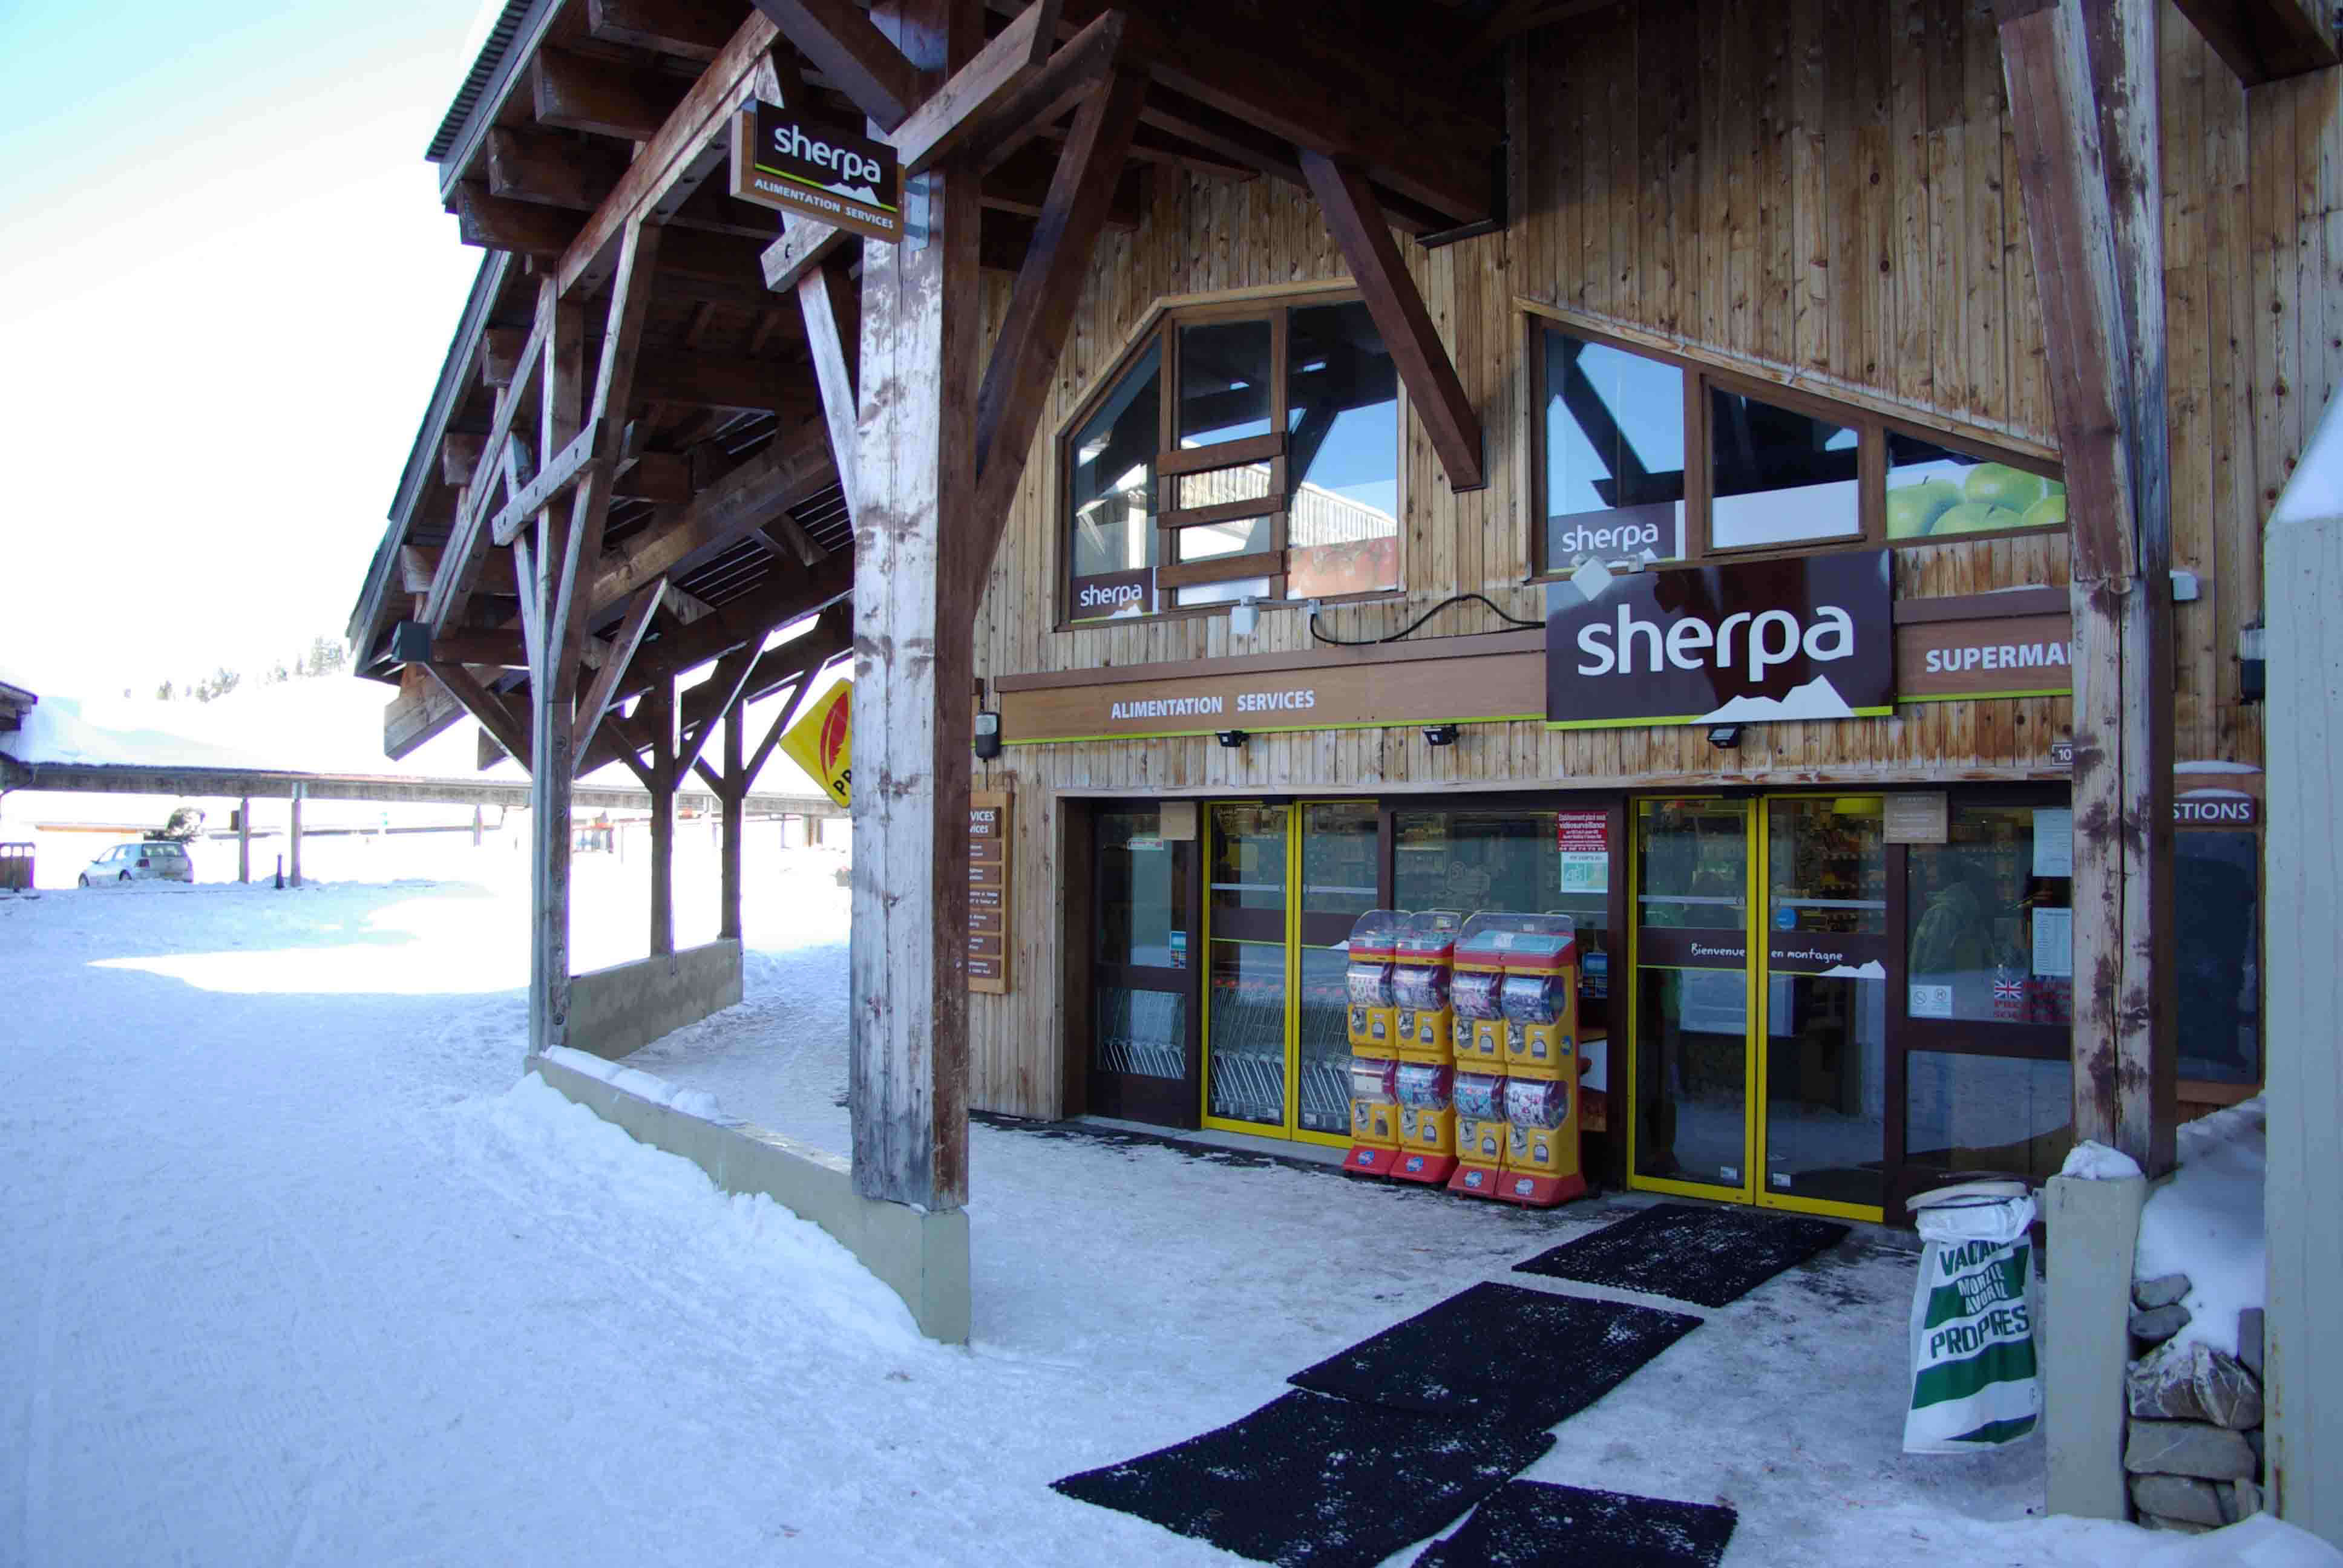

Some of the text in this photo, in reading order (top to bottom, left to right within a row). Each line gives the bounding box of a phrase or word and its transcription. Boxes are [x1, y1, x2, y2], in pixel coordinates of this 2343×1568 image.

[774, 124, 881, 183] sherpa
[755, 178, 894, 229] ALIMENTATION SERVICES
[1562, 523, 1659, 552] sherpa
[1080, 584, 1142, 607] sherpa
[1576, 604, 1855, 682] sherpa
[1926, 642, 2072, 673] SUPERMA
[1111, 690, 1315, 719] ALIMENTATION SERVICES
[1691, 942, 1843, 964] Bienvenue en montagne
[1930, 1304, 2030, 1359] PROPRES
